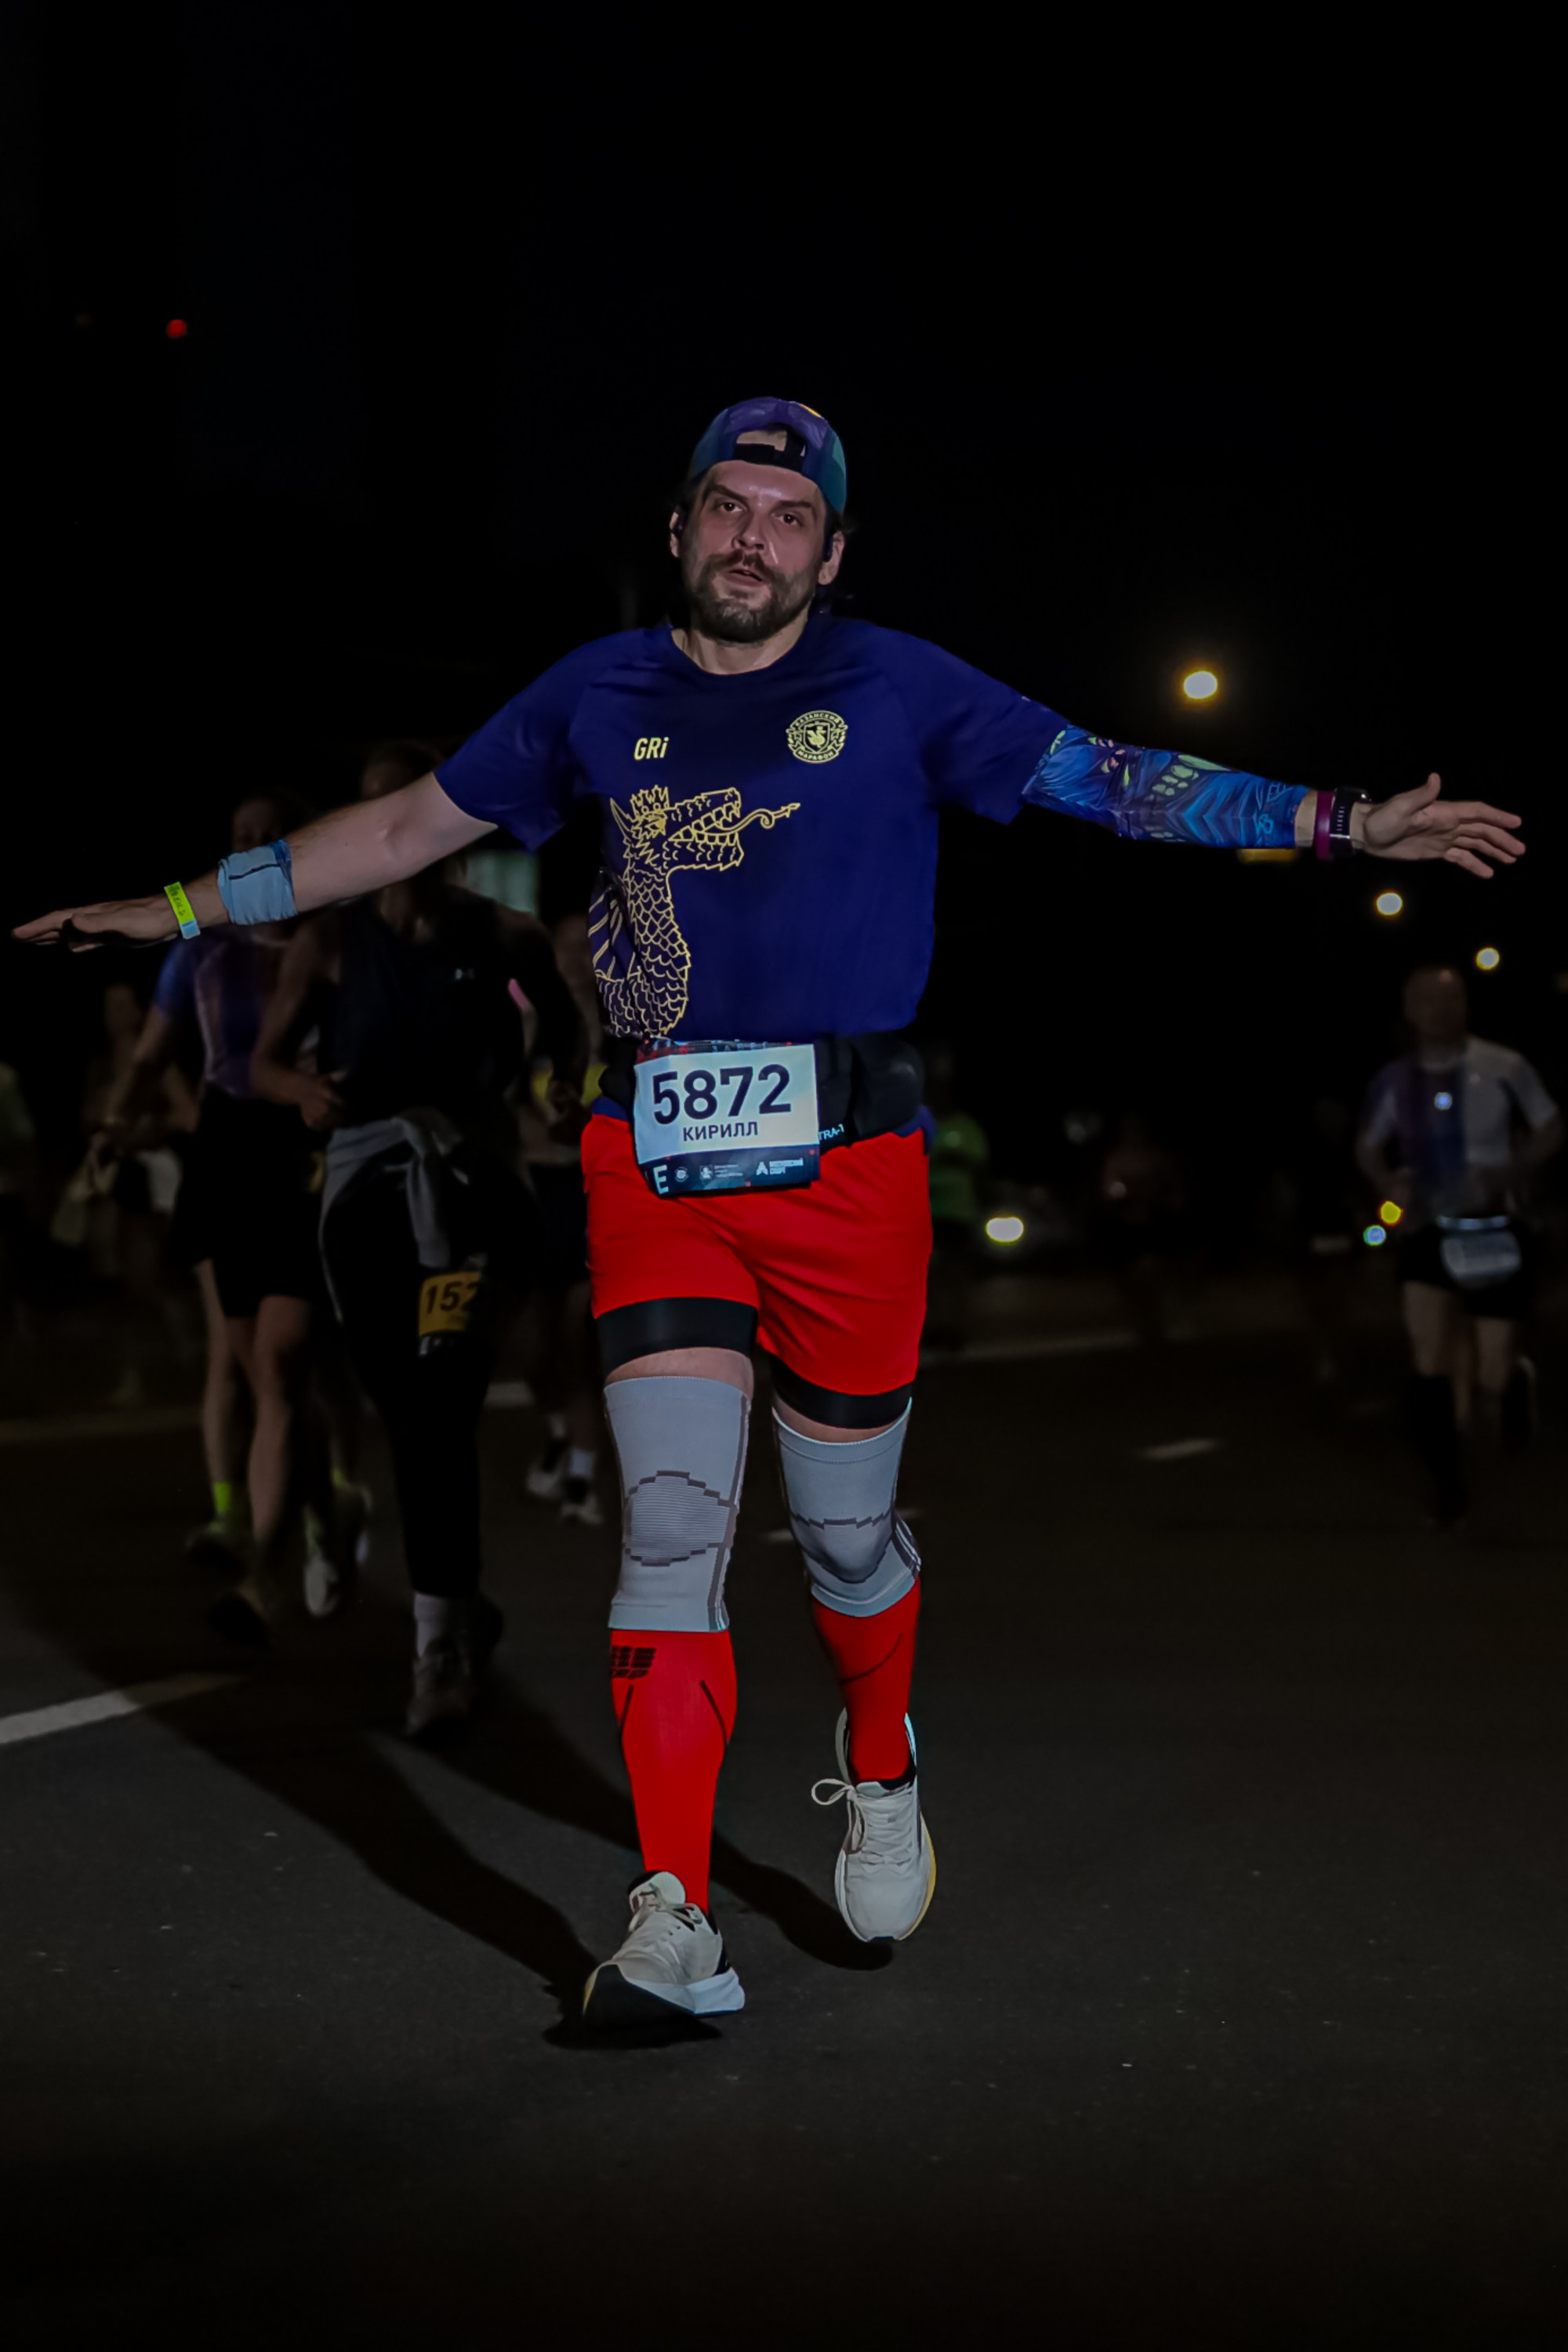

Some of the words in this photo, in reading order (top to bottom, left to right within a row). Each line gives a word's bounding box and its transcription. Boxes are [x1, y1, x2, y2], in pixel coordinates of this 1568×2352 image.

[633, 737, 670, 760] GRi
[797, 750, 834, 760] МАРАФОН
[652, 1064, 792, 1124] 5872
[683, 1121, 758, 1142] КИРИЛЛ
